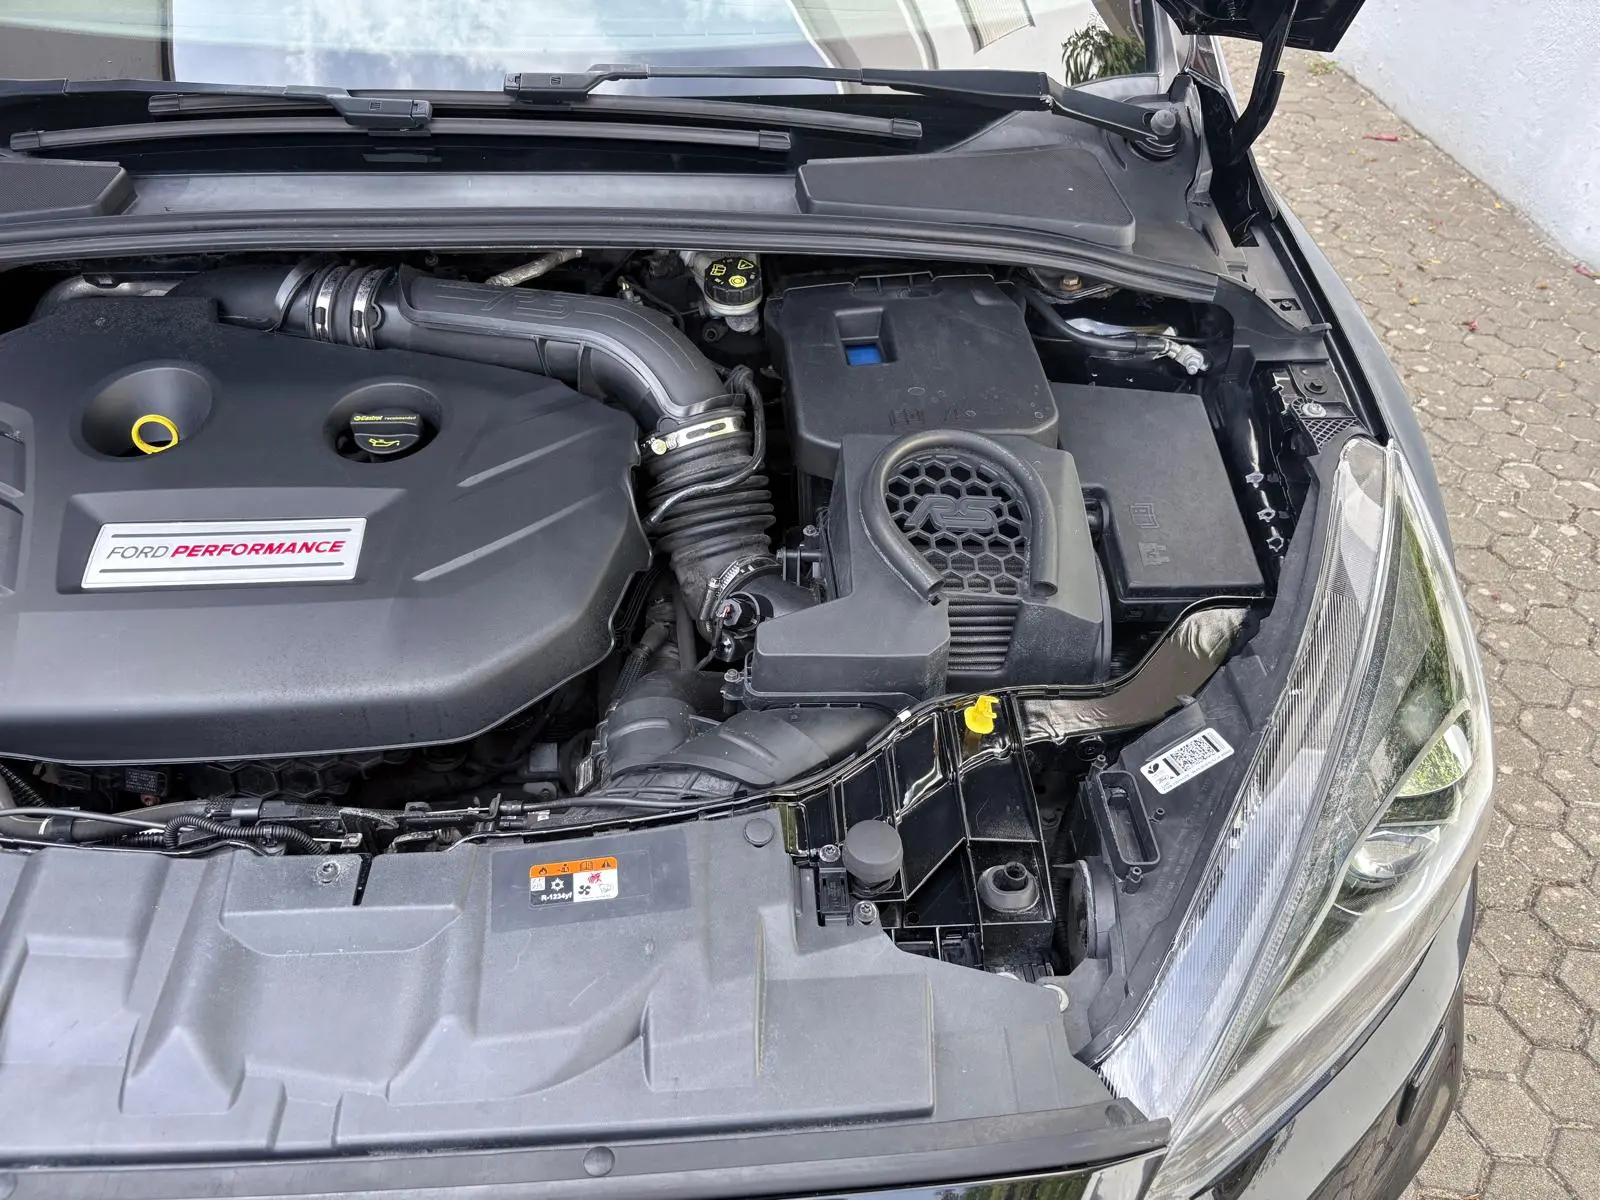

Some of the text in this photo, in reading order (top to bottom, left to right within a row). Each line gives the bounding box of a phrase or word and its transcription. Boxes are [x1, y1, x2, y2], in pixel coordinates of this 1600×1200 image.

[903, 494, 1002, 532] RS
[106, 540, 347, 560] FORD PERFORMANCE
[540, 891, 573, 902] R-1234yf
